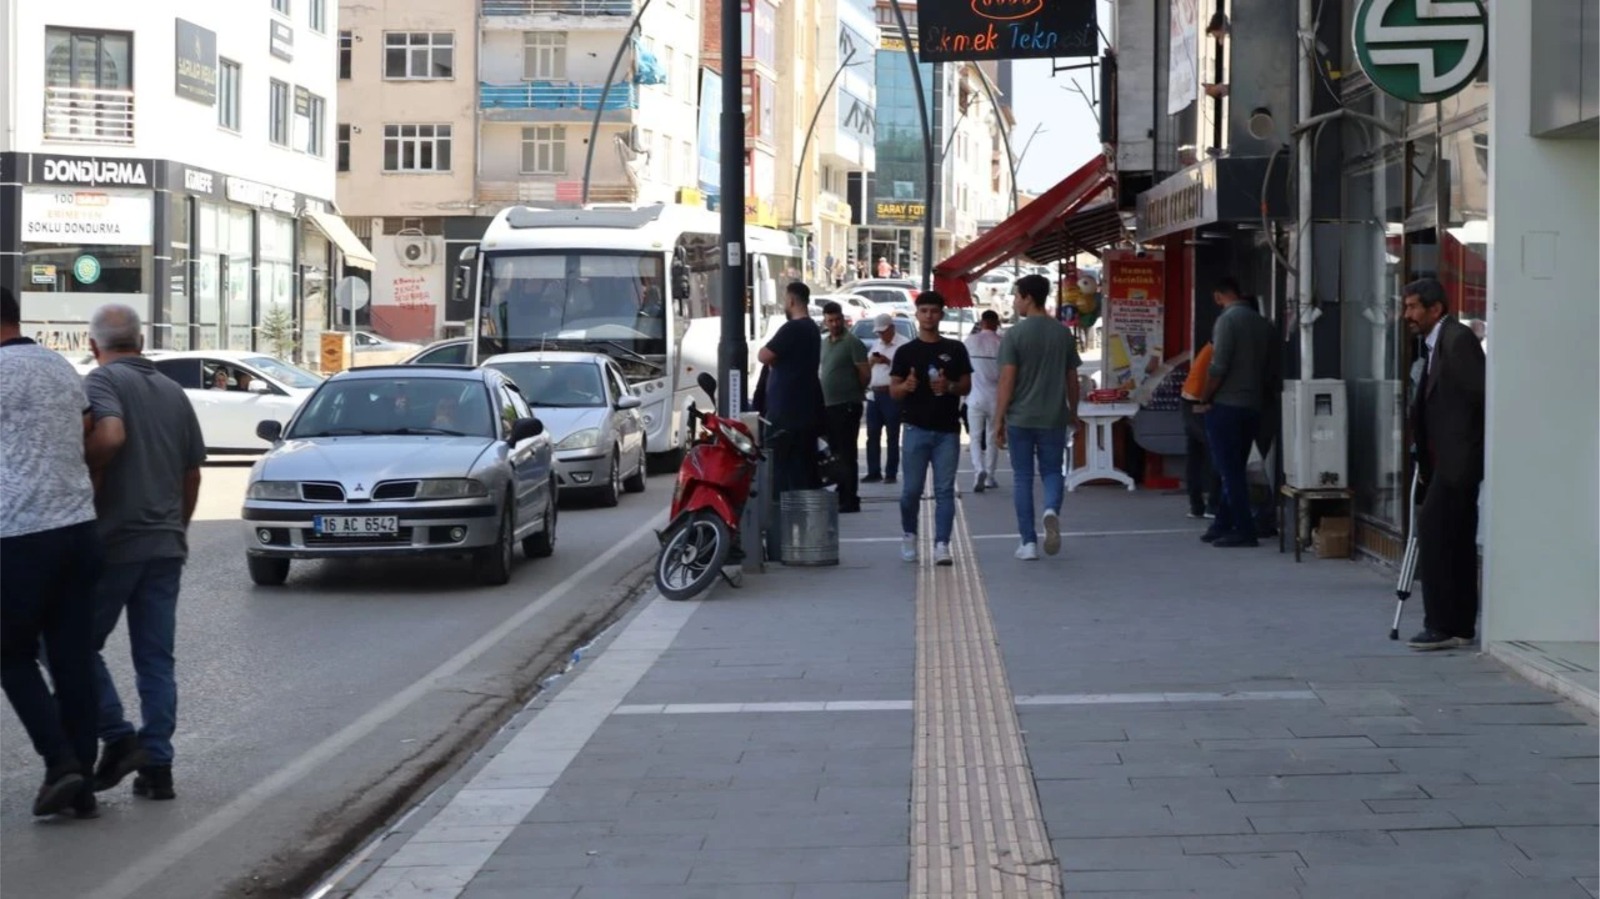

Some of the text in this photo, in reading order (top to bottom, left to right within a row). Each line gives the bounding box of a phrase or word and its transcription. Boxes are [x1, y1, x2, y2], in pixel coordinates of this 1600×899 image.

[925, 22, 999, 53] Ekmek
[44, 159, 147, 184] DONDURMA
[877, 203, 925, 216] SARAY FOT
[64, 222, 121, 234] DONDURMA
[324, 517, 396, 532] 16 AC 6542
